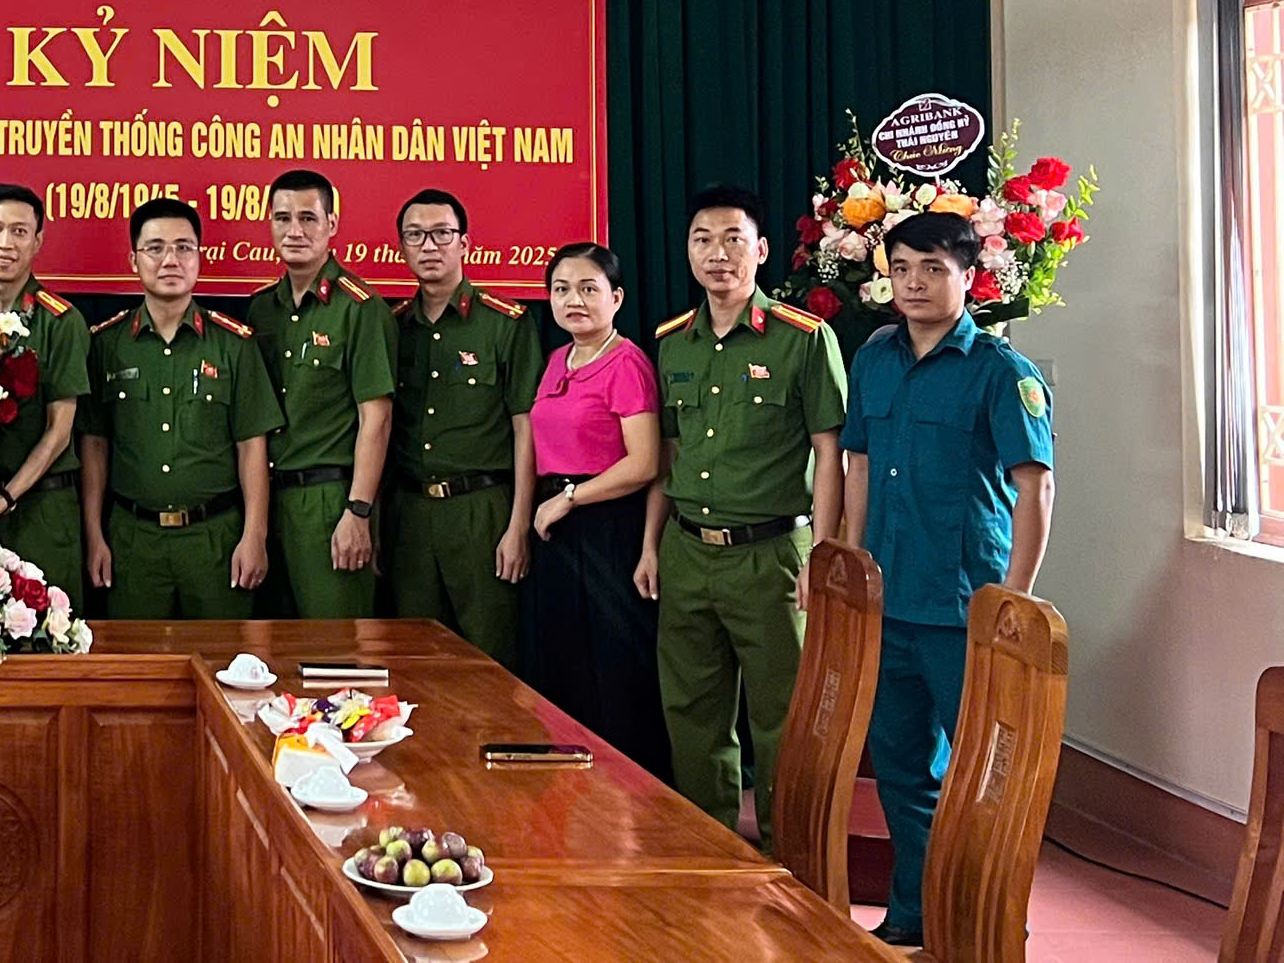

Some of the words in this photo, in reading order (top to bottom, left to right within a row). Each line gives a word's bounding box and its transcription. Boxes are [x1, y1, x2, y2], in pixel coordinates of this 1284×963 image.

[7, 5, 129, 87] KỶ
[152, 11, 379, 107] NIỆM
[890, 107, 962, 127] AGRIBANK
[100, 108, 183, 157] THỐNG
[191, 115, 261, 158] CÔNG
[268, 124, 304, 159] AN
[313, 117, 384, 160] NHÂN
[392, 118, 444, 161] DÂN
[452, 119, 505, 170] VIỆT
[514, 128, 574, 164] NAM
[878, 130, 894, 141] CHI
[896, 123, 928, 138] NHÁNH
[896, 136, 918, 148] THÁI
[919, 129, 958, 145] NGUYÊN
[890, 149, 921, 162] Chúc
[923, 142, 963, 156] Mừng
[199, 241, 227, 264] rại
[232, 241, 281, 264] Cau,
[344, 243, 368, 263] 19
